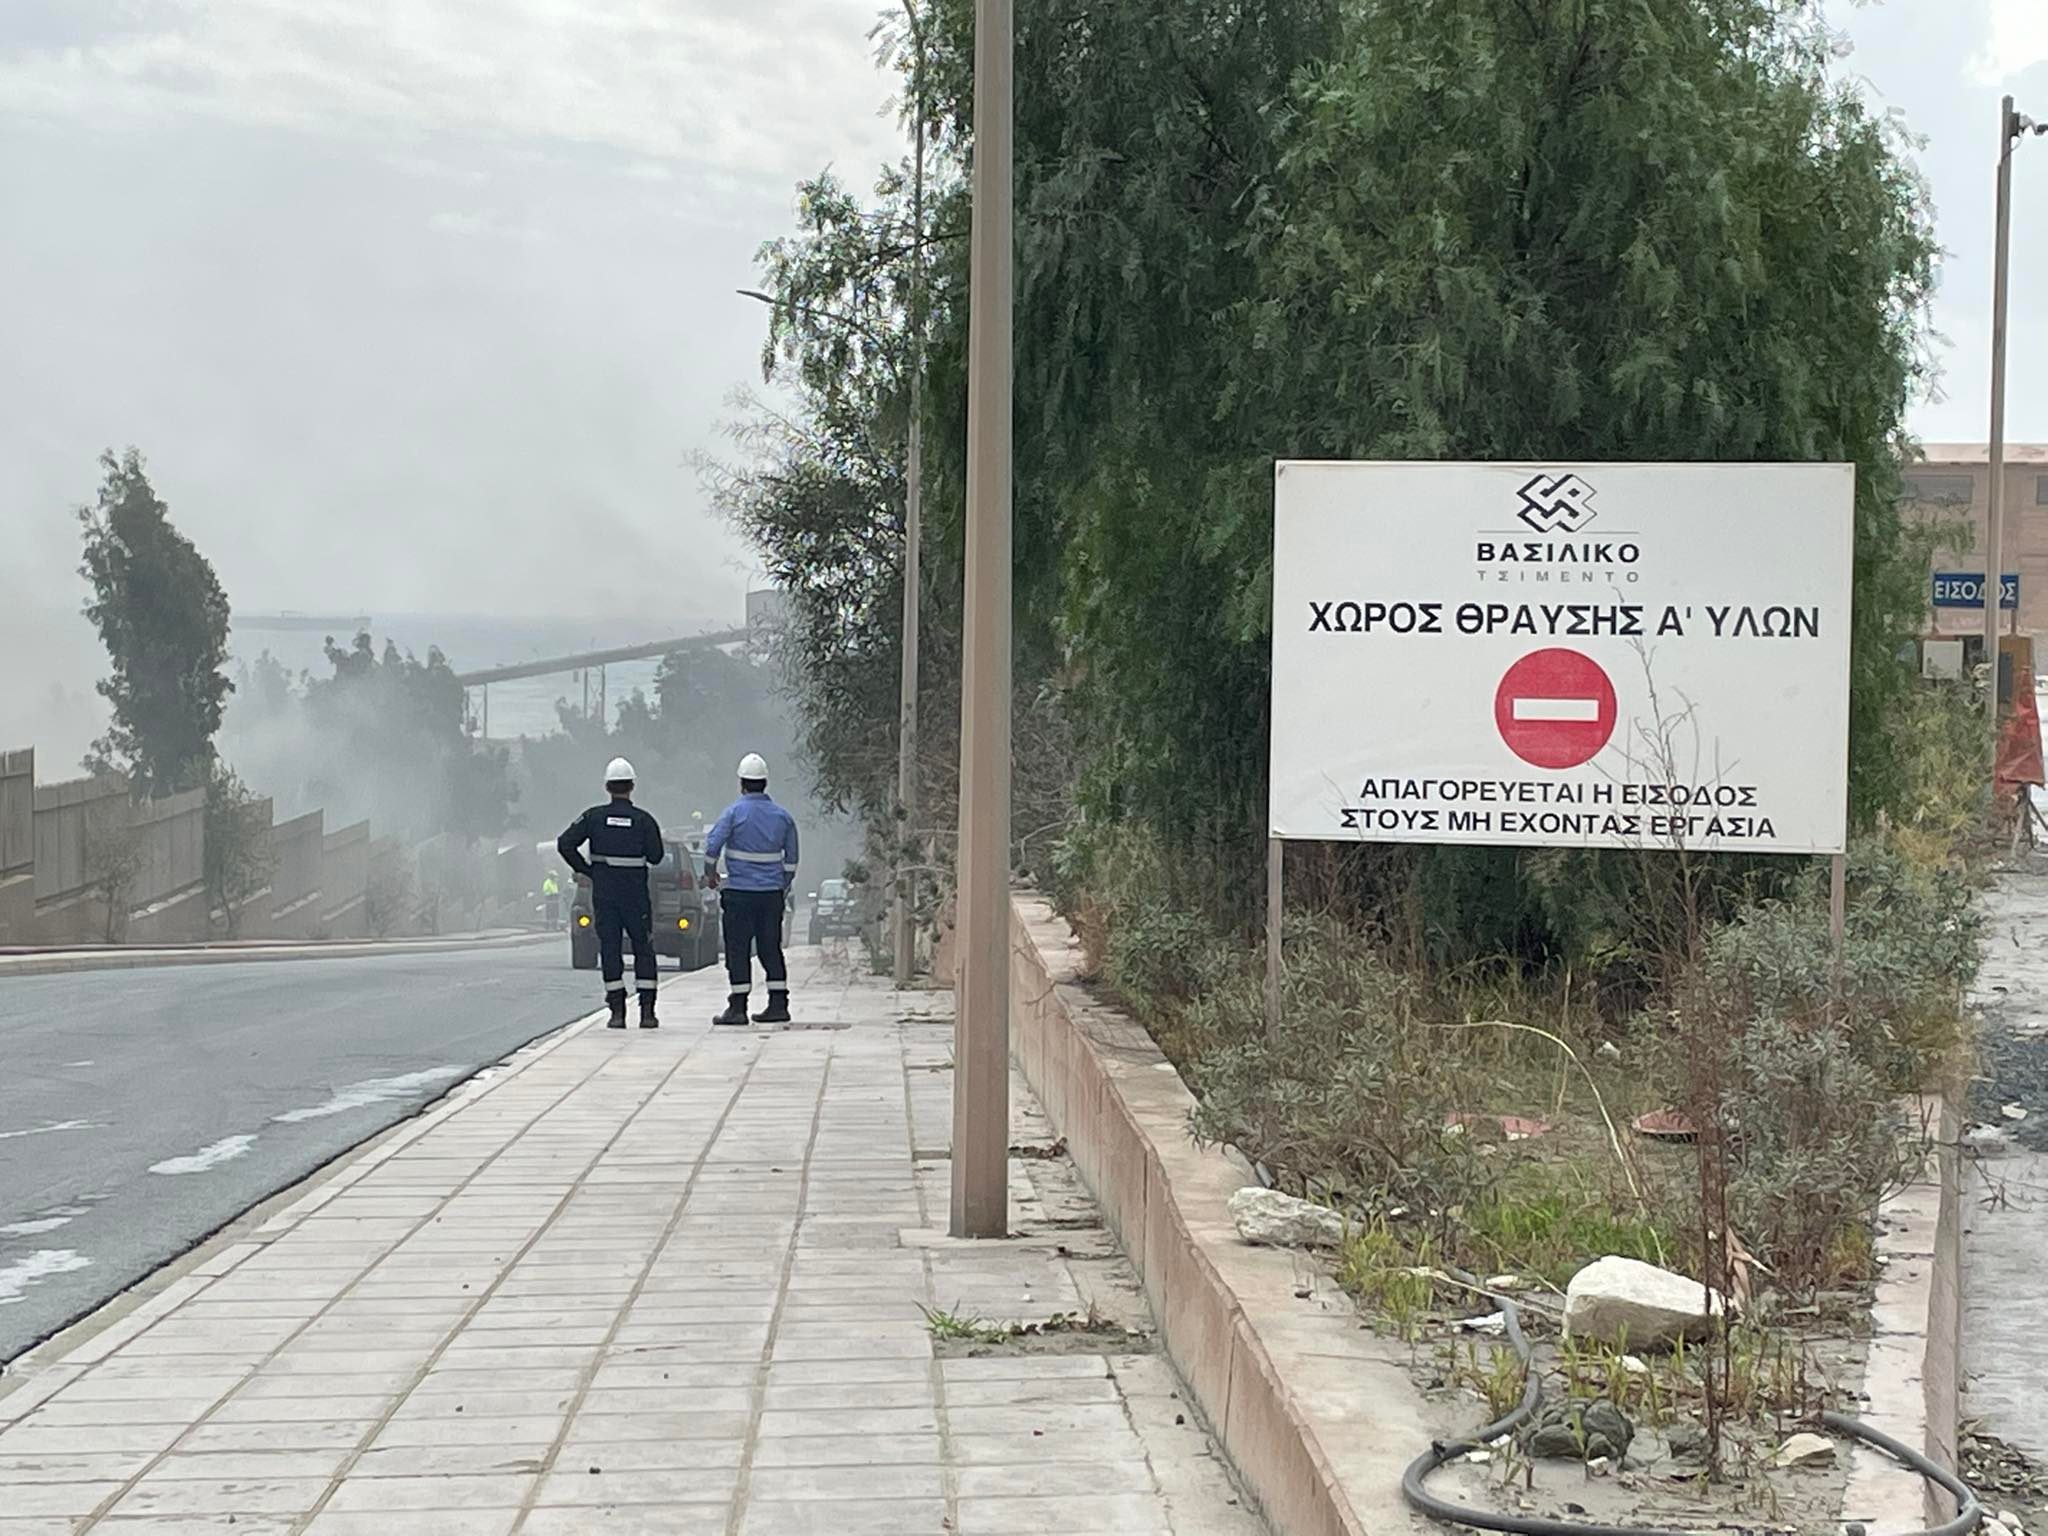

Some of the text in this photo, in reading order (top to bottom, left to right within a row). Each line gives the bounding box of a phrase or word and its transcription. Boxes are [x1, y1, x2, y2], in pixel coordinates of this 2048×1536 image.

[1477, 543, 1640, 563] ΒΑΣΙΛΙΚΟ
[1477, 570, 1639, 583] ΤΣΙΜΕΝΤΟ
[1308, 601, 1443, 633] ΧΩΡΟΣ
[1456, 603, 1643, 635] ΘΡΑΥΣΗΣ
[1705, 606, 1819, 637] ΥΛΩΝ
[1360, 778, 1757, 806] ΑΠΑΓΟΡΕΥΕΤΑΙ Η ΕΙΣΟΔΟΣ
[1340, 808, 1776, 838] ΣΤΟΥΣ ΜΗ ΕΧΟΝΤΑΣ ΕΡΓΑΣΙΑ
